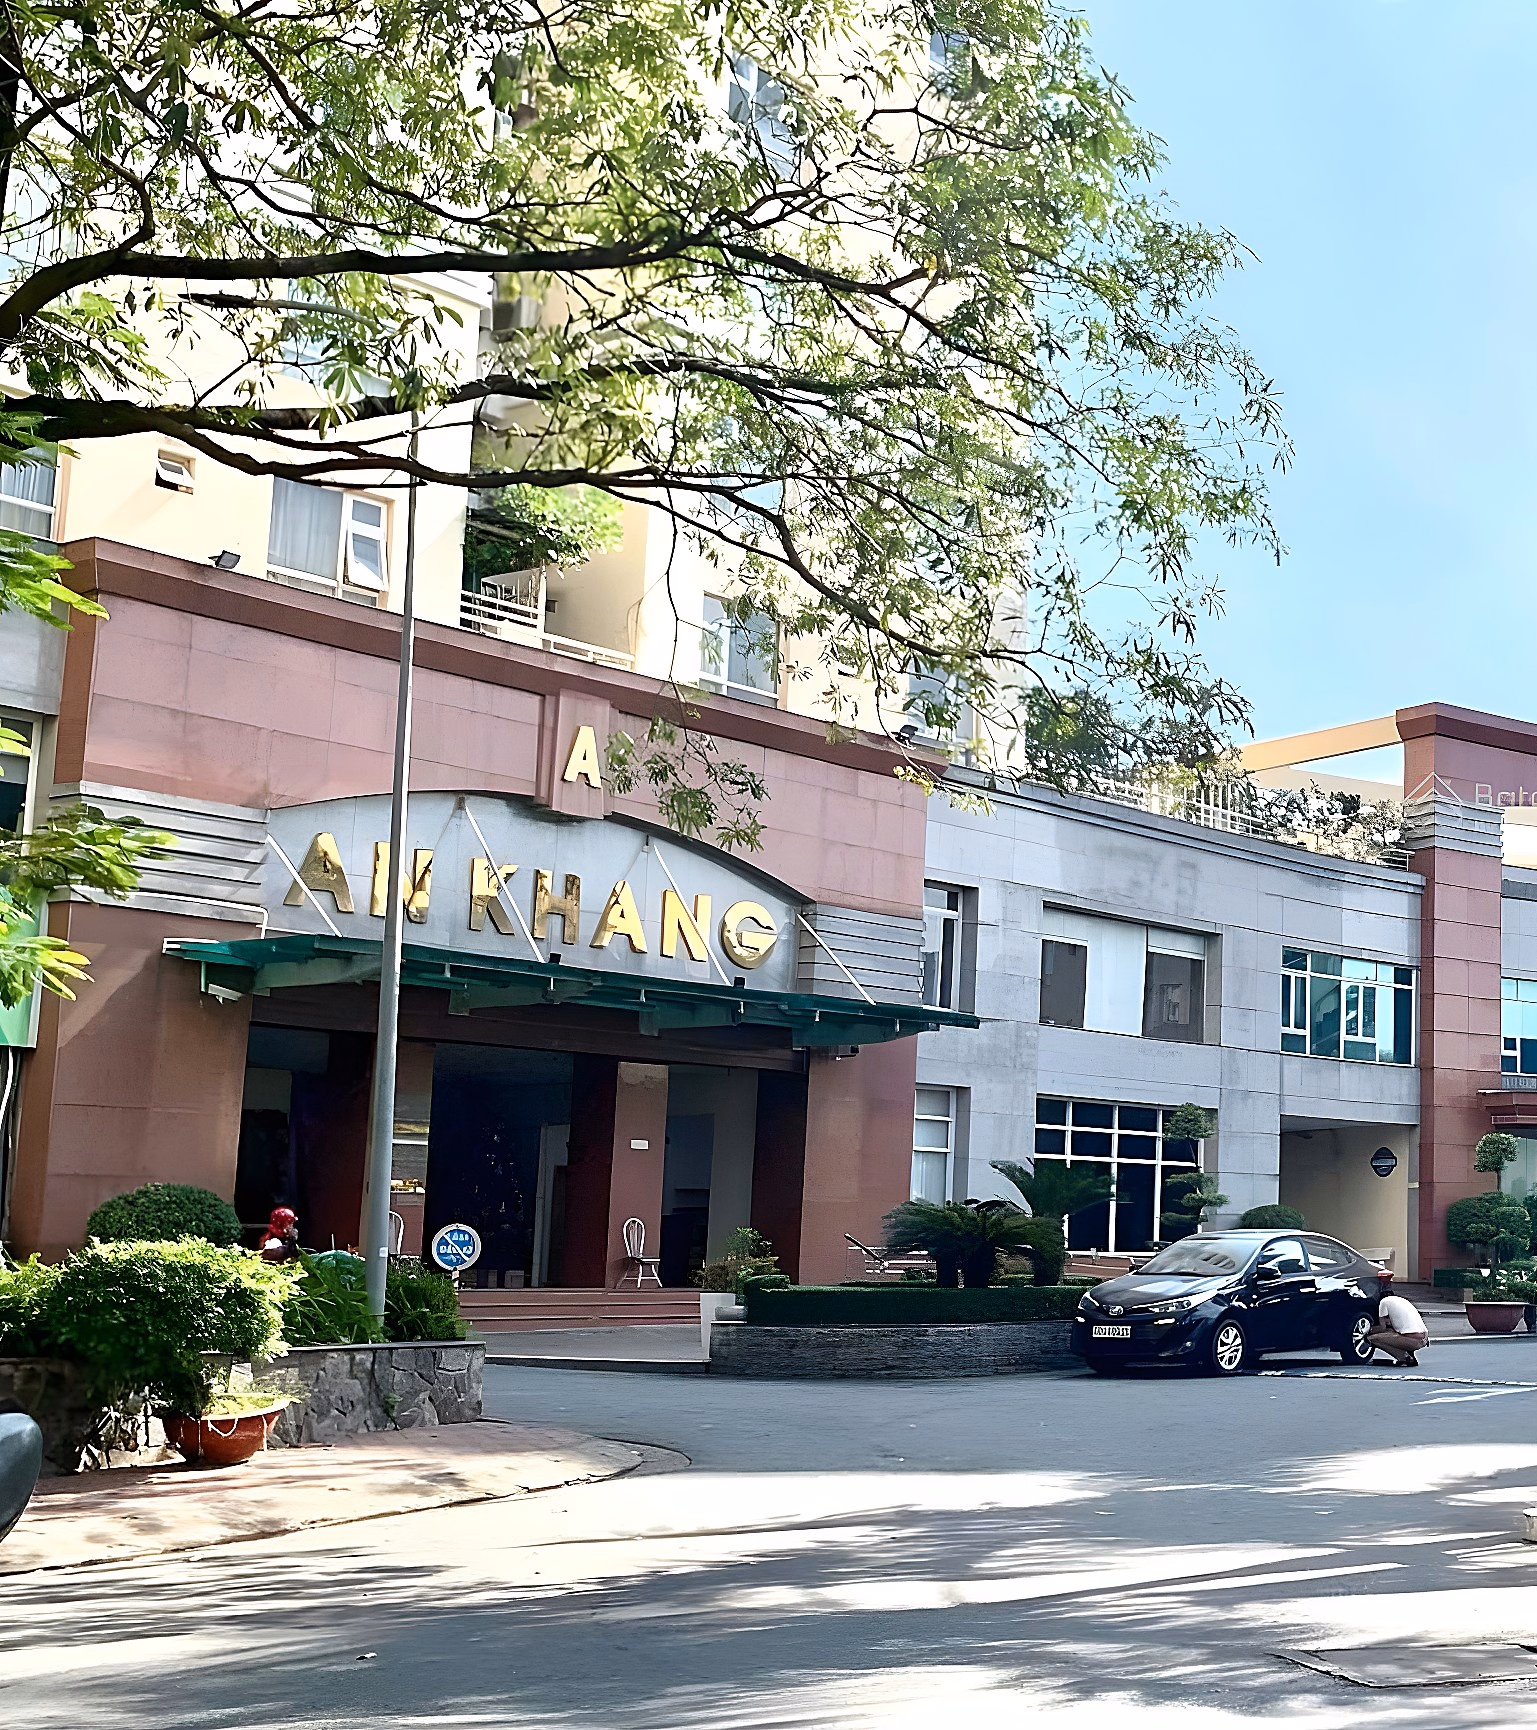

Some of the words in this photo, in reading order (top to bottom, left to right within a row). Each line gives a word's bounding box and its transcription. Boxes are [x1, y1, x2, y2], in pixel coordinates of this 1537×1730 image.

[562, 725, 602, 789] A
[283, 831, 433, 925] AN
[468, 856, 778, 970] KHANG
